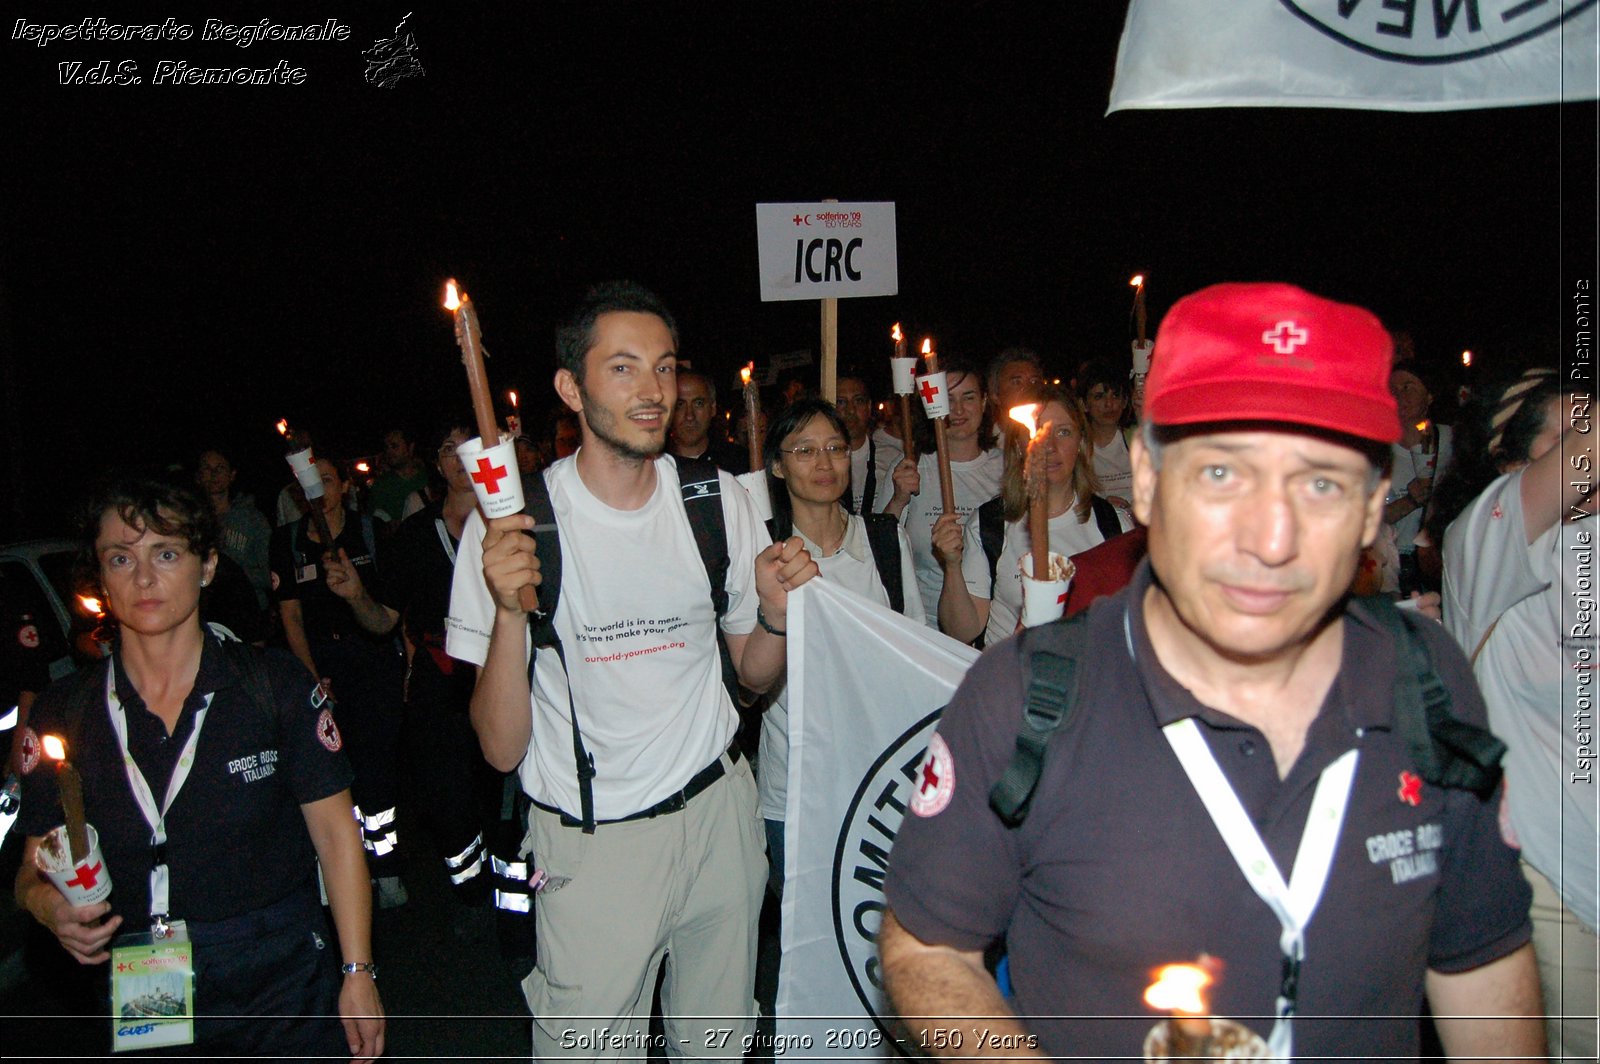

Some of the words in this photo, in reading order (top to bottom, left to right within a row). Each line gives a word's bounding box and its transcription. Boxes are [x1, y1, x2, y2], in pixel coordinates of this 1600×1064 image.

[816, 211, 849, 221] solferino
[837, 219, 862, 229] YEARS
[795, 237, 863, 283] ICRC
[600, 620, 624, 633] world
[626, 619, 634, 627] is
[637, 618, 646, 626] in
[605, 634, 614, 642] to
[616, 629, 641, 640] make
[643, 628, 665, 636] your
[228, 755, 259, 774] CROCE
[243, 764, 277, 783] ITALIANA
[1365, 829, 1414, 864] CROCE
